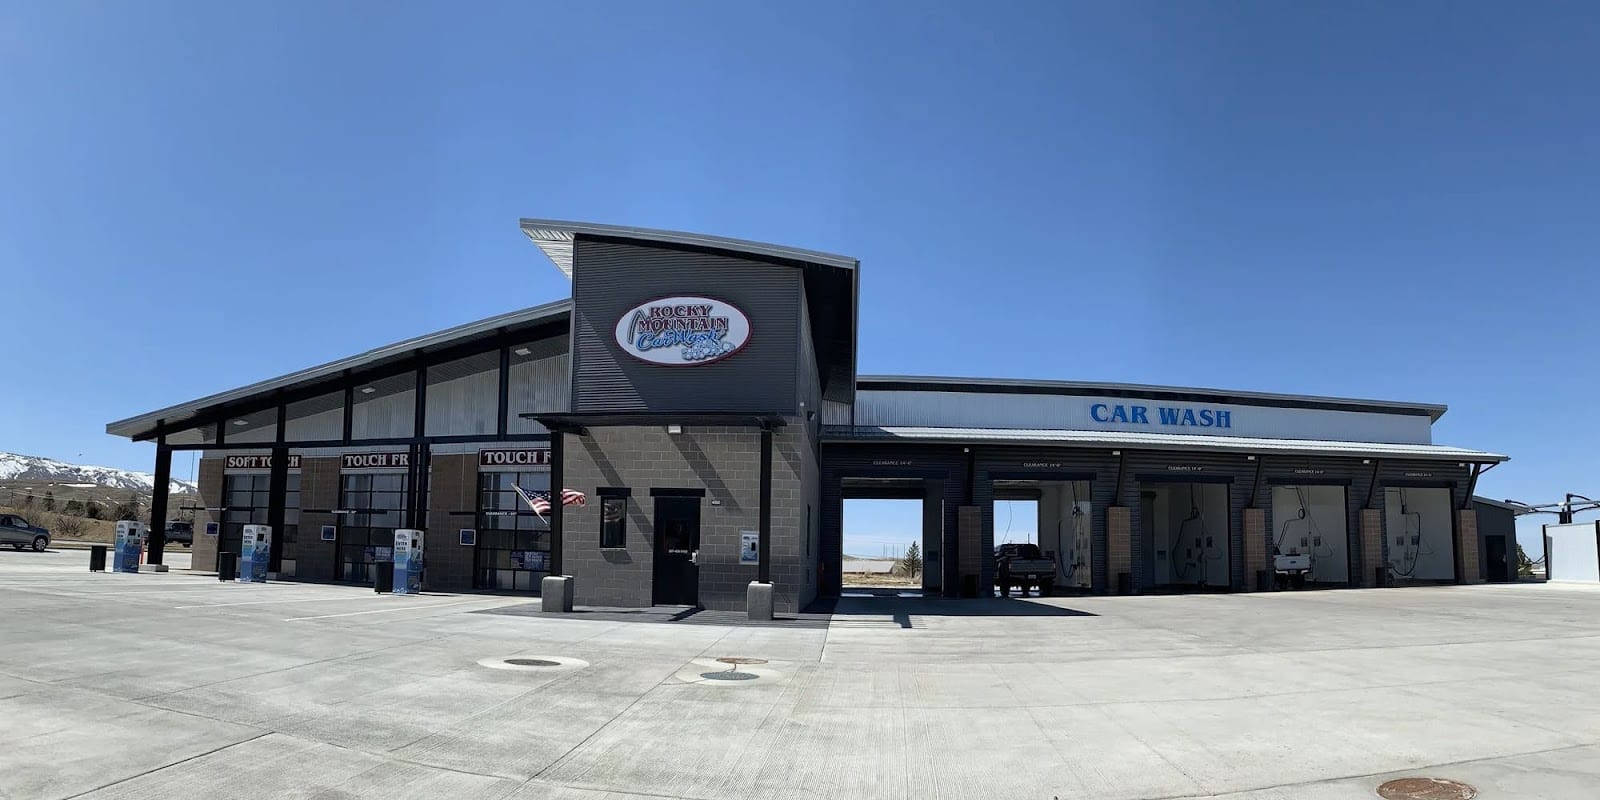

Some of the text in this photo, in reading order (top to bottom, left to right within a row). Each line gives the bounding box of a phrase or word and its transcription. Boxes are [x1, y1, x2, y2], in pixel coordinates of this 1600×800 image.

[650, 304, 711, 317] ROCKY
[638, 317, 728, 333] MOUNTAIN
[1090, 403, 1231, 428] CAR WASH
[228, 456, 299, 467] SOFT TOH
[345, 453, 409, 467] TOUCH FR
[484, 451, 537, 464] TOUCH
